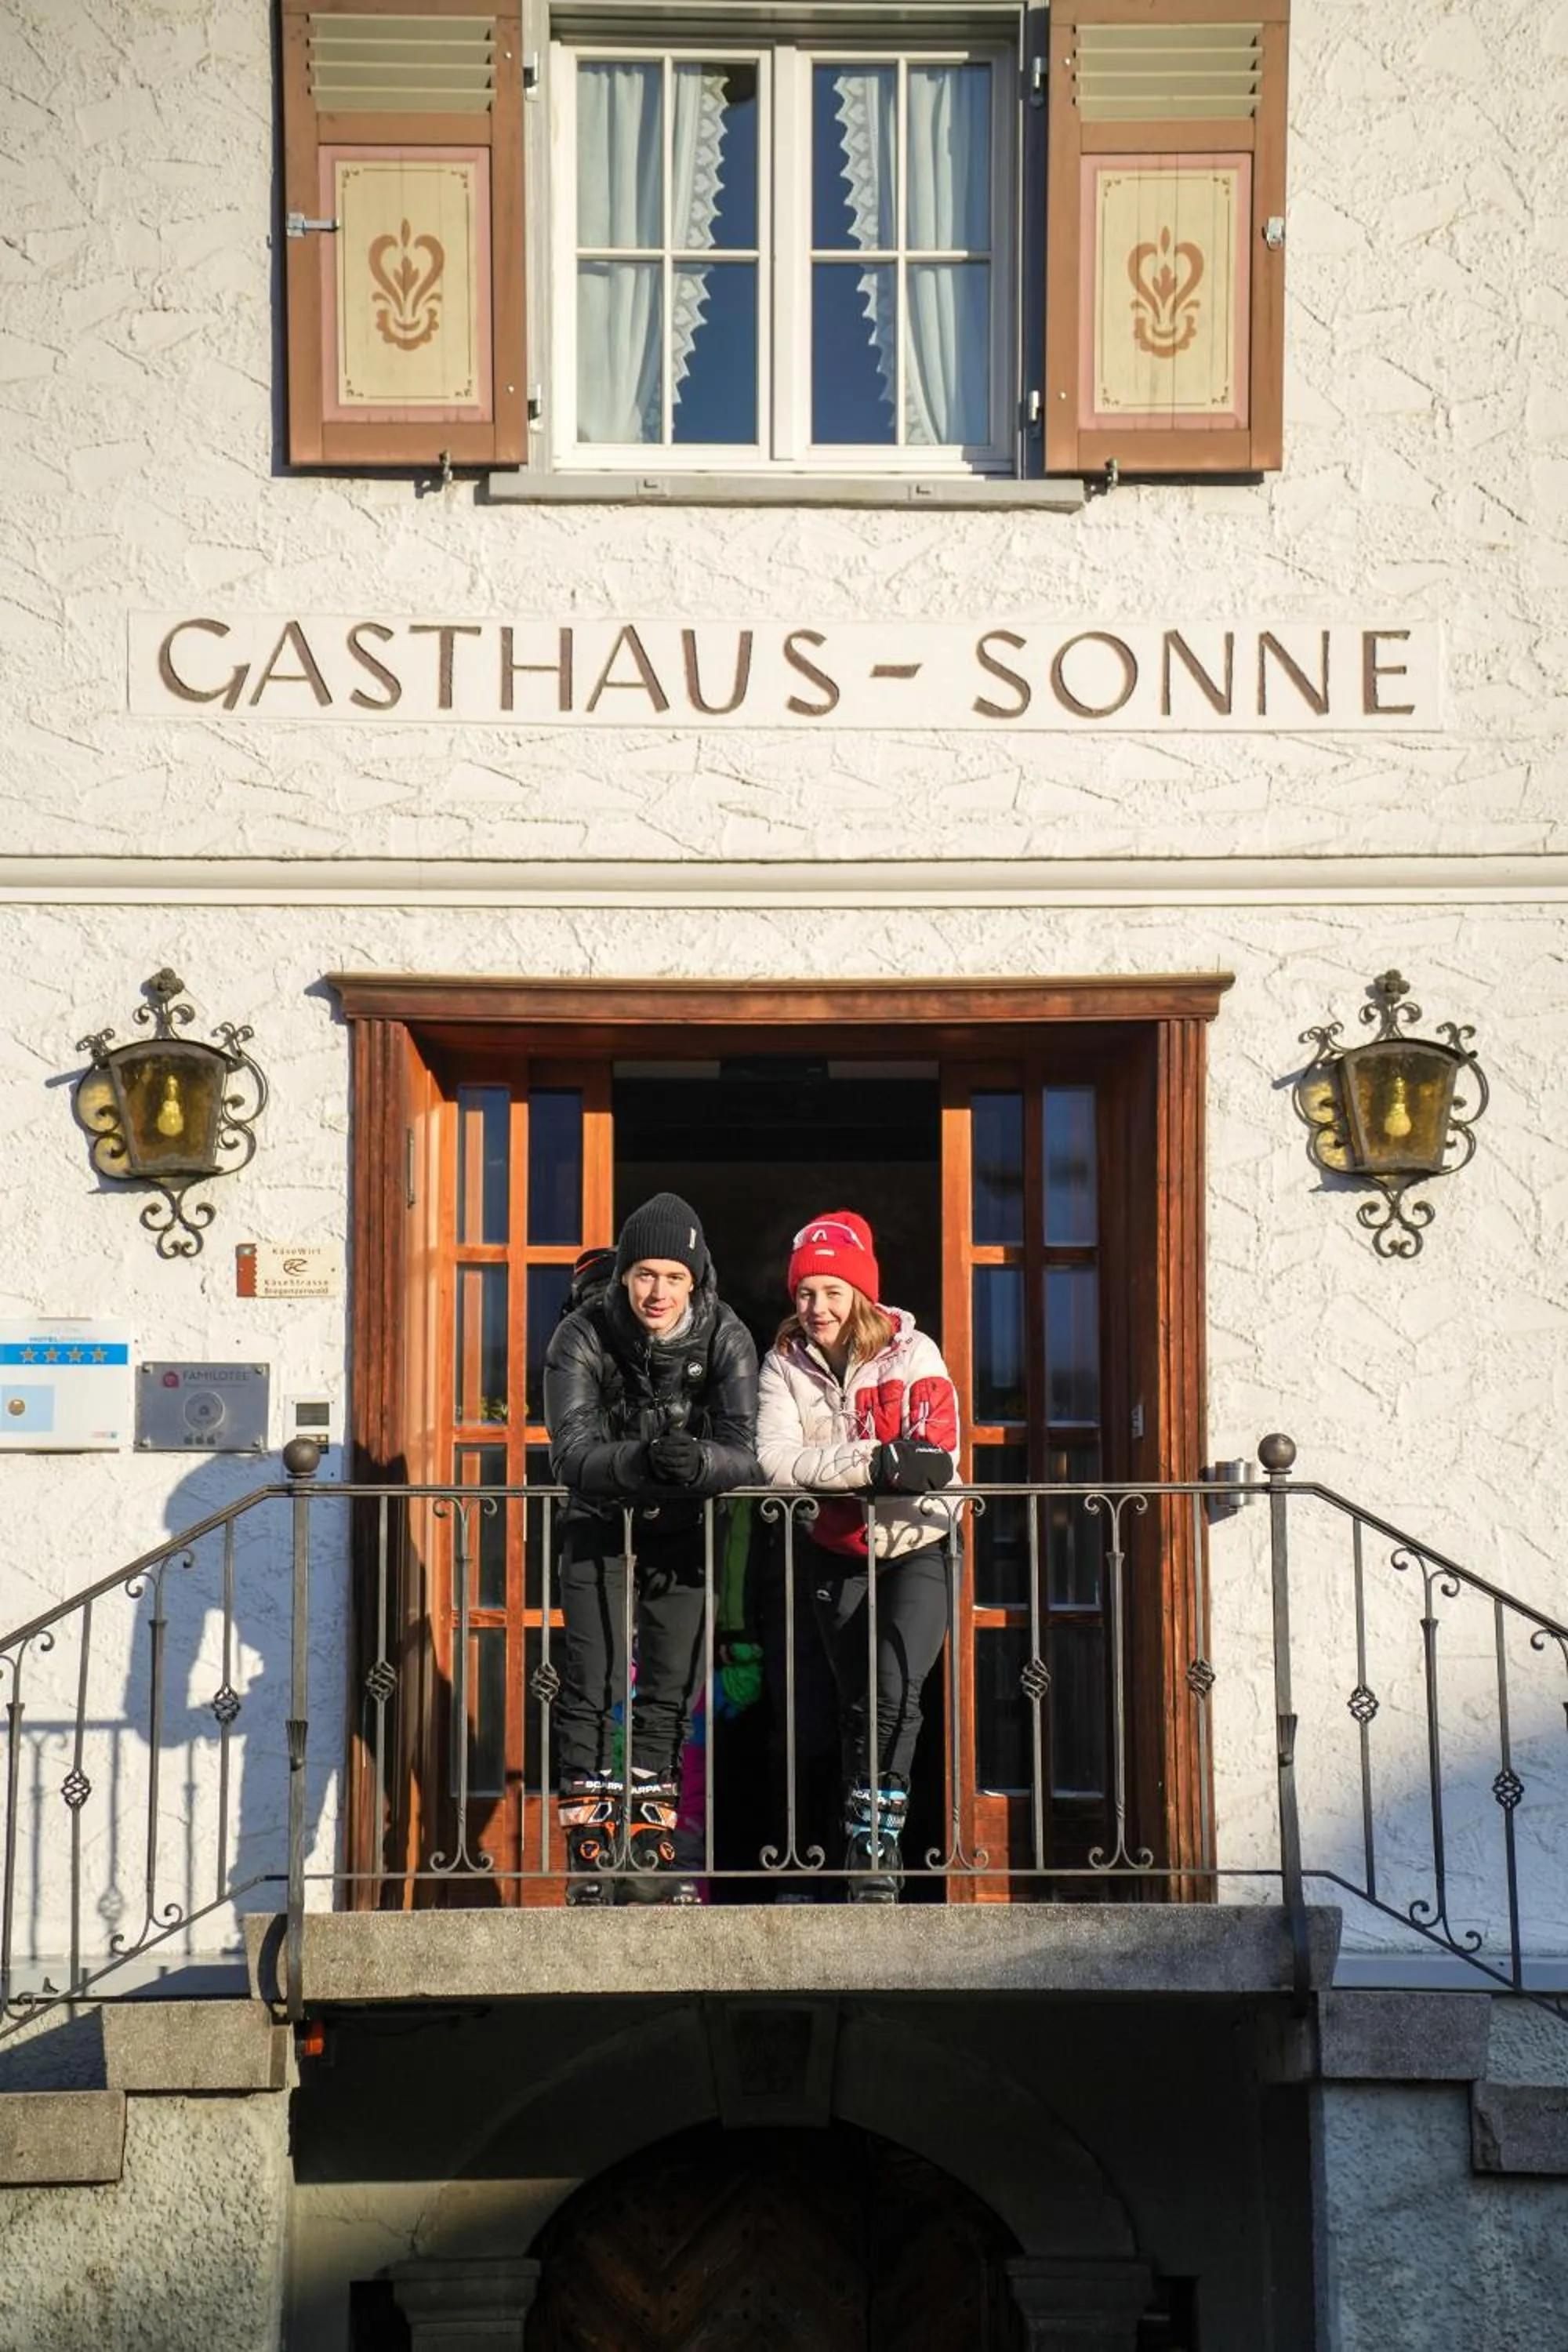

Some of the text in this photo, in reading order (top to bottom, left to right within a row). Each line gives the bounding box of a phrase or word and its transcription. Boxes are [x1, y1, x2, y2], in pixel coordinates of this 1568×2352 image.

[157, 618, 841, 717] GASTHAUS
[971, 629, 1416, 719] SONNE
[183, 1370, 252, 1381] FAMILOTEL
